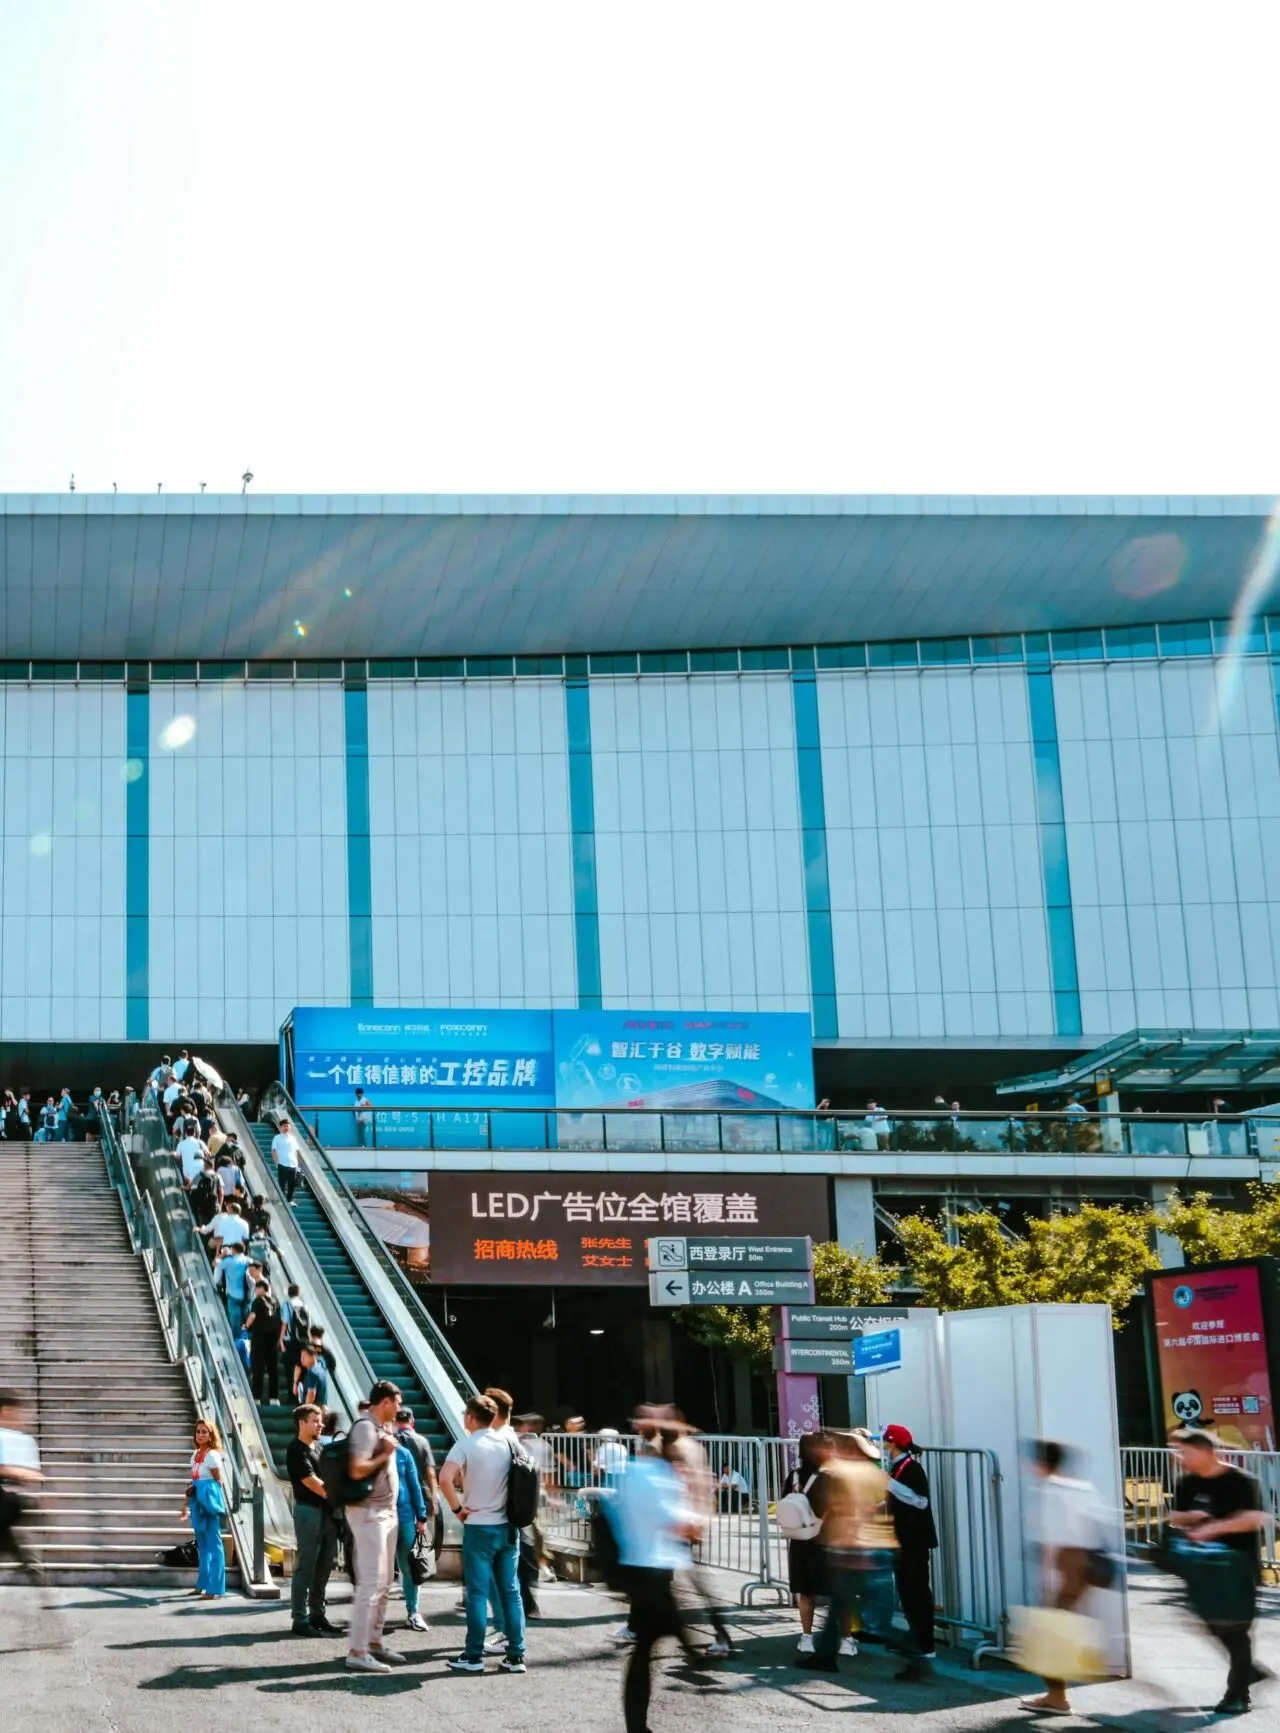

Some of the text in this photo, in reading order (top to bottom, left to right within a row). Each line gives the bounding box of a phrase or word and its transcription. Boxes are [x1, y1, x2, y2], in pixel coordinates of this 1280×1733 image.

[689, 1042, 761, 1060] 数字赋能
[308, 1058, 537, 1087] 一个值得信赖的工控品牌
[471, 1191, 758, 1224] LED广告位全馆覆盖
[474, 1239, 558, 1260] 招商热线
[581, 1237, 632, 1249] 张先生
[581, 1255, 633, 1267] 艾女士
[689, 1246, 746, 1261] 西登录厅
[692, 1281, 752, 1296] 办公楼 A
[775, 1281, 803, 1289] Building
[791, 1314, 811, 1322] Public
[811, 1314, 833, 1322] Transit
[791, 1349, 849, 1357] INTERCONTINENTAL
